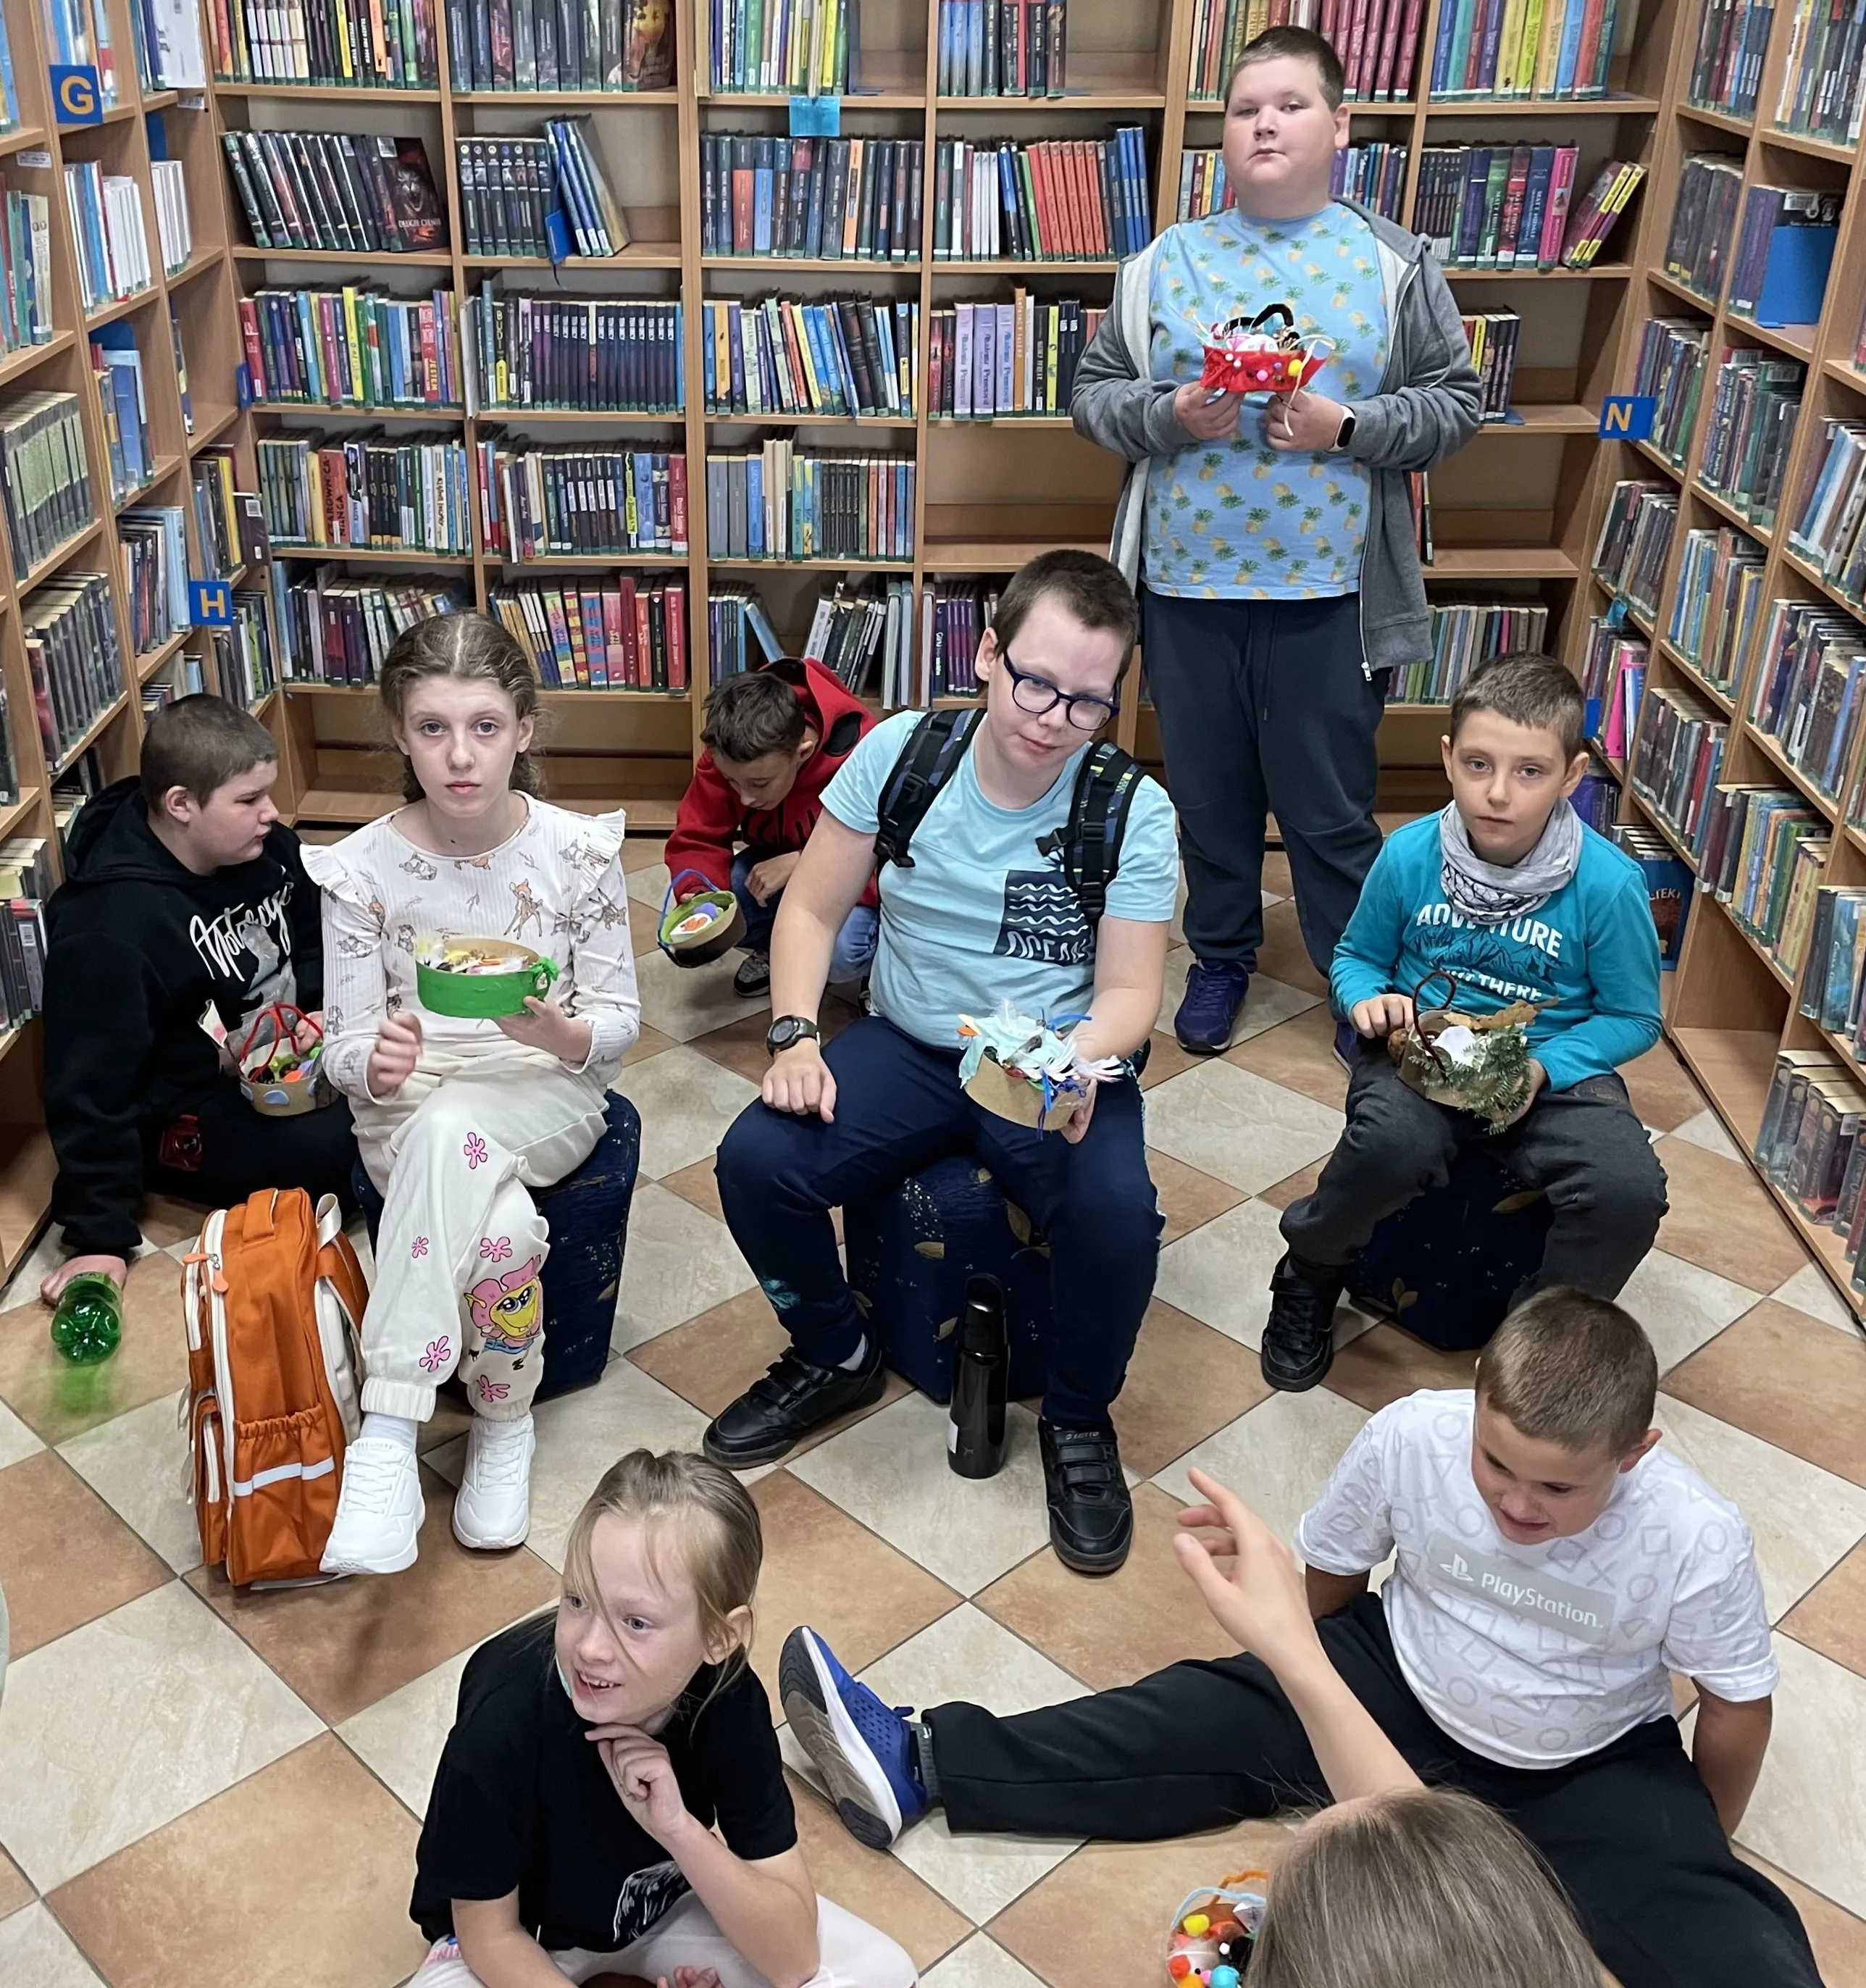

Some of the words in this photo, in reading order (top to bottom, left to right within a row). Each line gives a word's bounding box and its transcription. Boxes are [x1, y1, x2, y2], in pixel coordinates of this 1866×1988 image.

[60, 76, 94, 114] G
[429, 359, 438, 391] JESTEM
[1604, 403, 1632, 432] N
[199, 588, 226, 618] H
[1074, 1431, 1100, 1440] LOTTO
[1481, 1572, 1597, 1628] PlayStation
